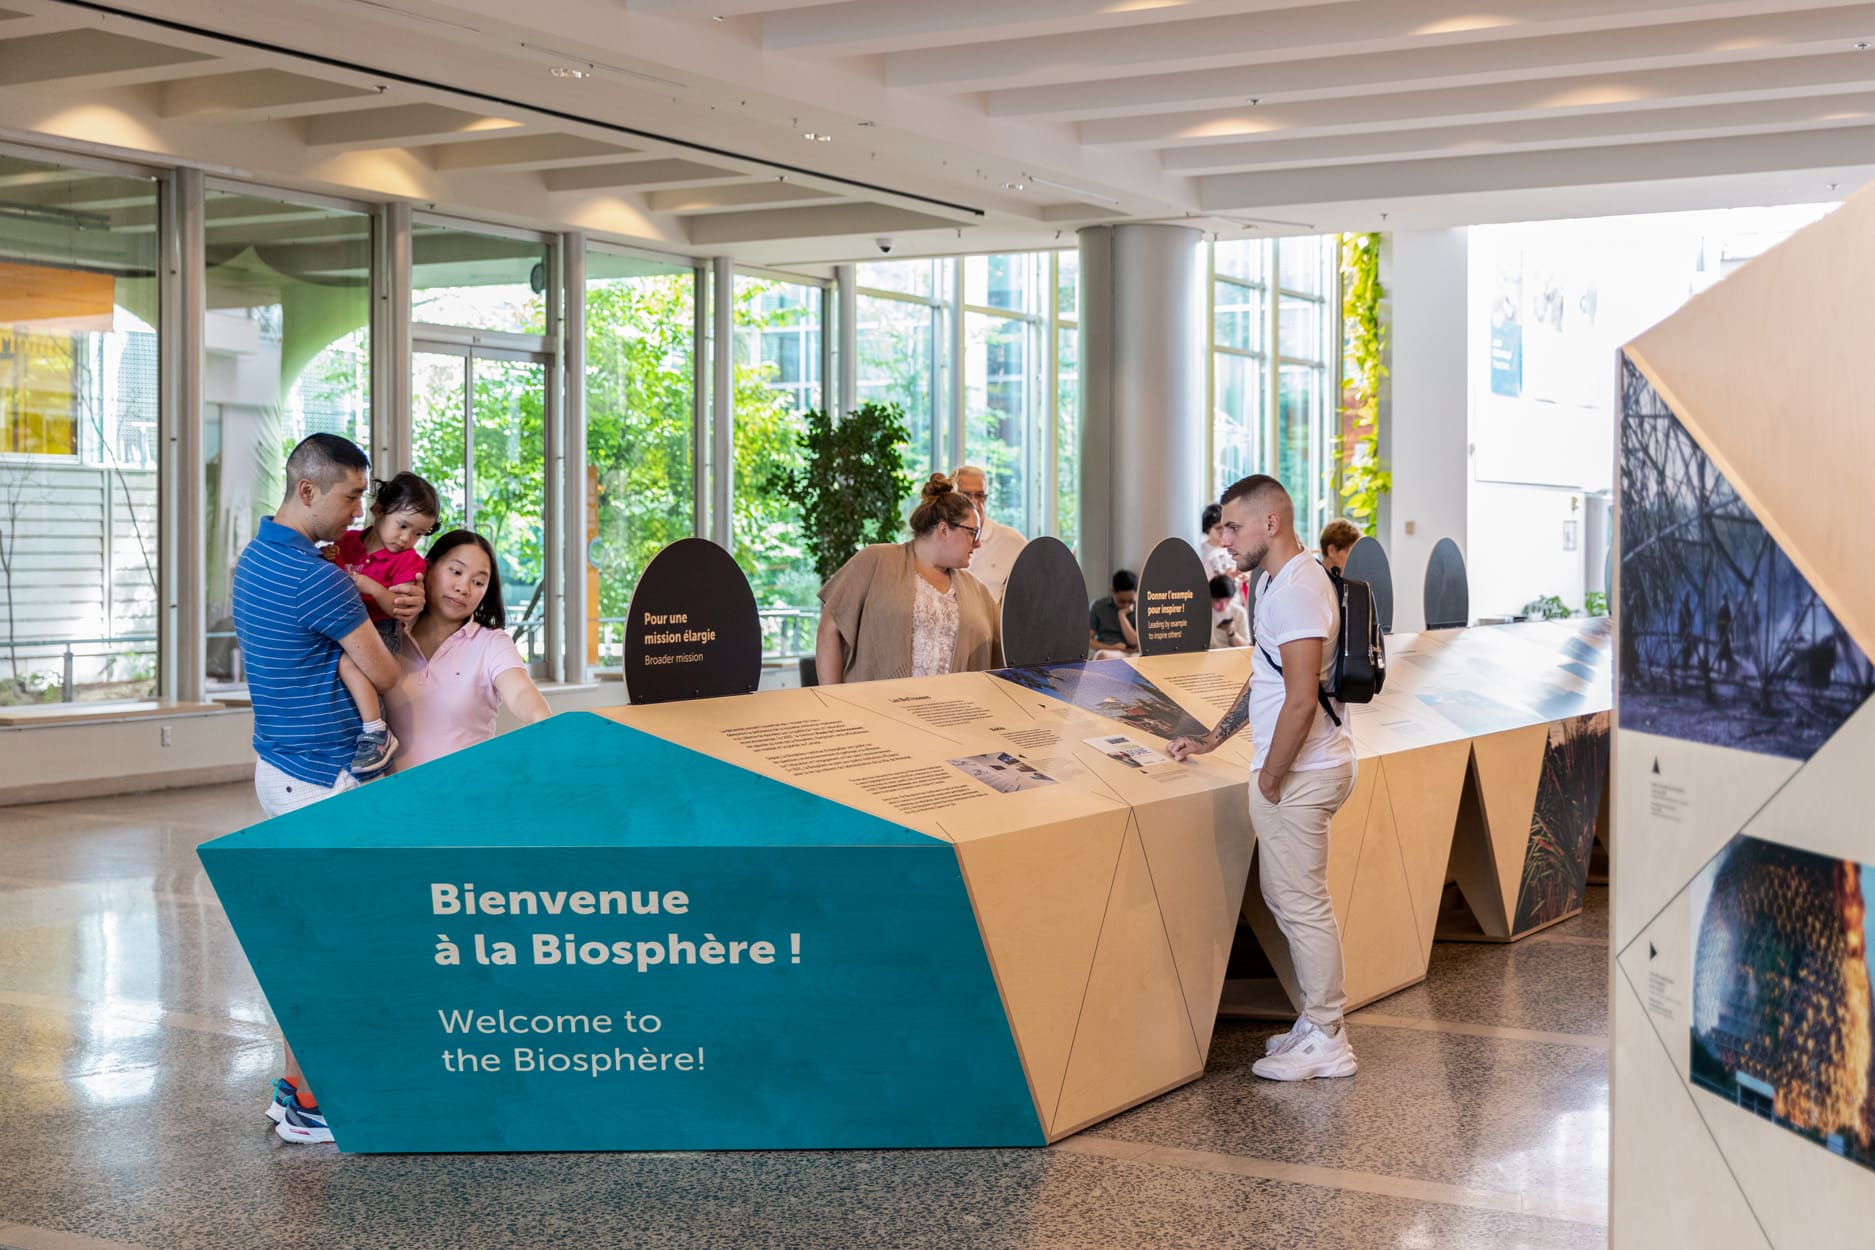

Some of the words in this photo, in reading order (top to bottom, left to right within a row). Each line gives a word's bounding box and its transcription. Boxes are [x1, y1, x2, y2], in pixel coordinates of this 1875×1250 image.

[1147, 591, 1167, 600] Donner
[1147, 606, 1161, 616] pour
[1161, 604, 1182, 616] inspirer
[644, 612, 668, 625] Pour
[669, 613, 688, 624] une
[1148, 620, 1164, 629] Leading
[1165, 620, 1170, 629] by
[1170, 619, 1188, 628] example
[644, 631, 682, 645] mission
[683, 628, 716, 645] élargie
[644, 653, 674, 666] Broader
[675, 651, 704, 663] mission
[431, 883, 689, 915] Bienvenue
[434, 934, 461, 965] à
[474, 933, 517, 965] la
[532, 933, 776, 973] Biosphère
[790, 932, 801, 964] !
[438, 1009, 612, 1034] Welcome
[624, 1010, 662, 1033] to
[442, 1048, 501, 1072] the
[514, 1046, 705, 1078] Biosphère!
